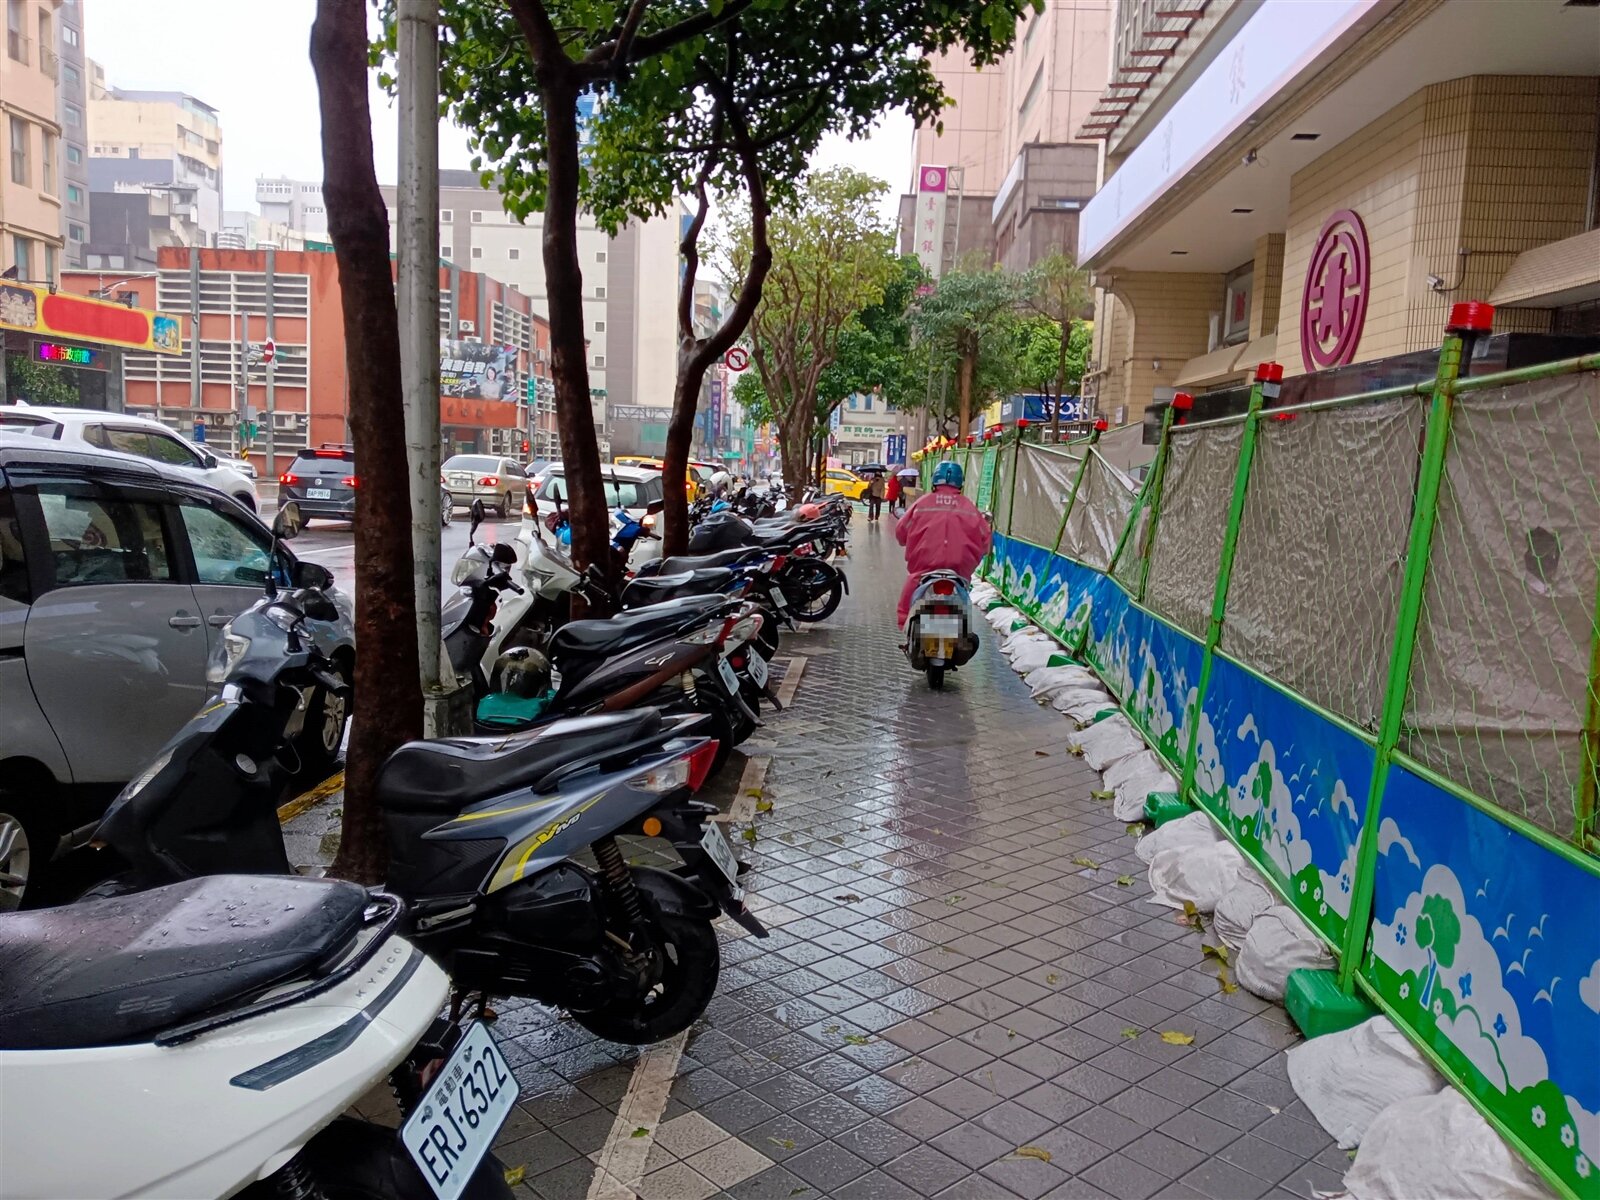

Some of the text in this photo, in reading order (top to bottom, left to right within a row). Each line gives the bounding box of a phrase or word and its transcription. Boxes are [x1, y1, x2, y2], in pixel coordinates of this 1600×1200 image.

[355, 947, 403, 998] KYMCO
[434, 1062, 465, 1108] 電動車
[418, 1046, 508, 1188] ERJ-6322
